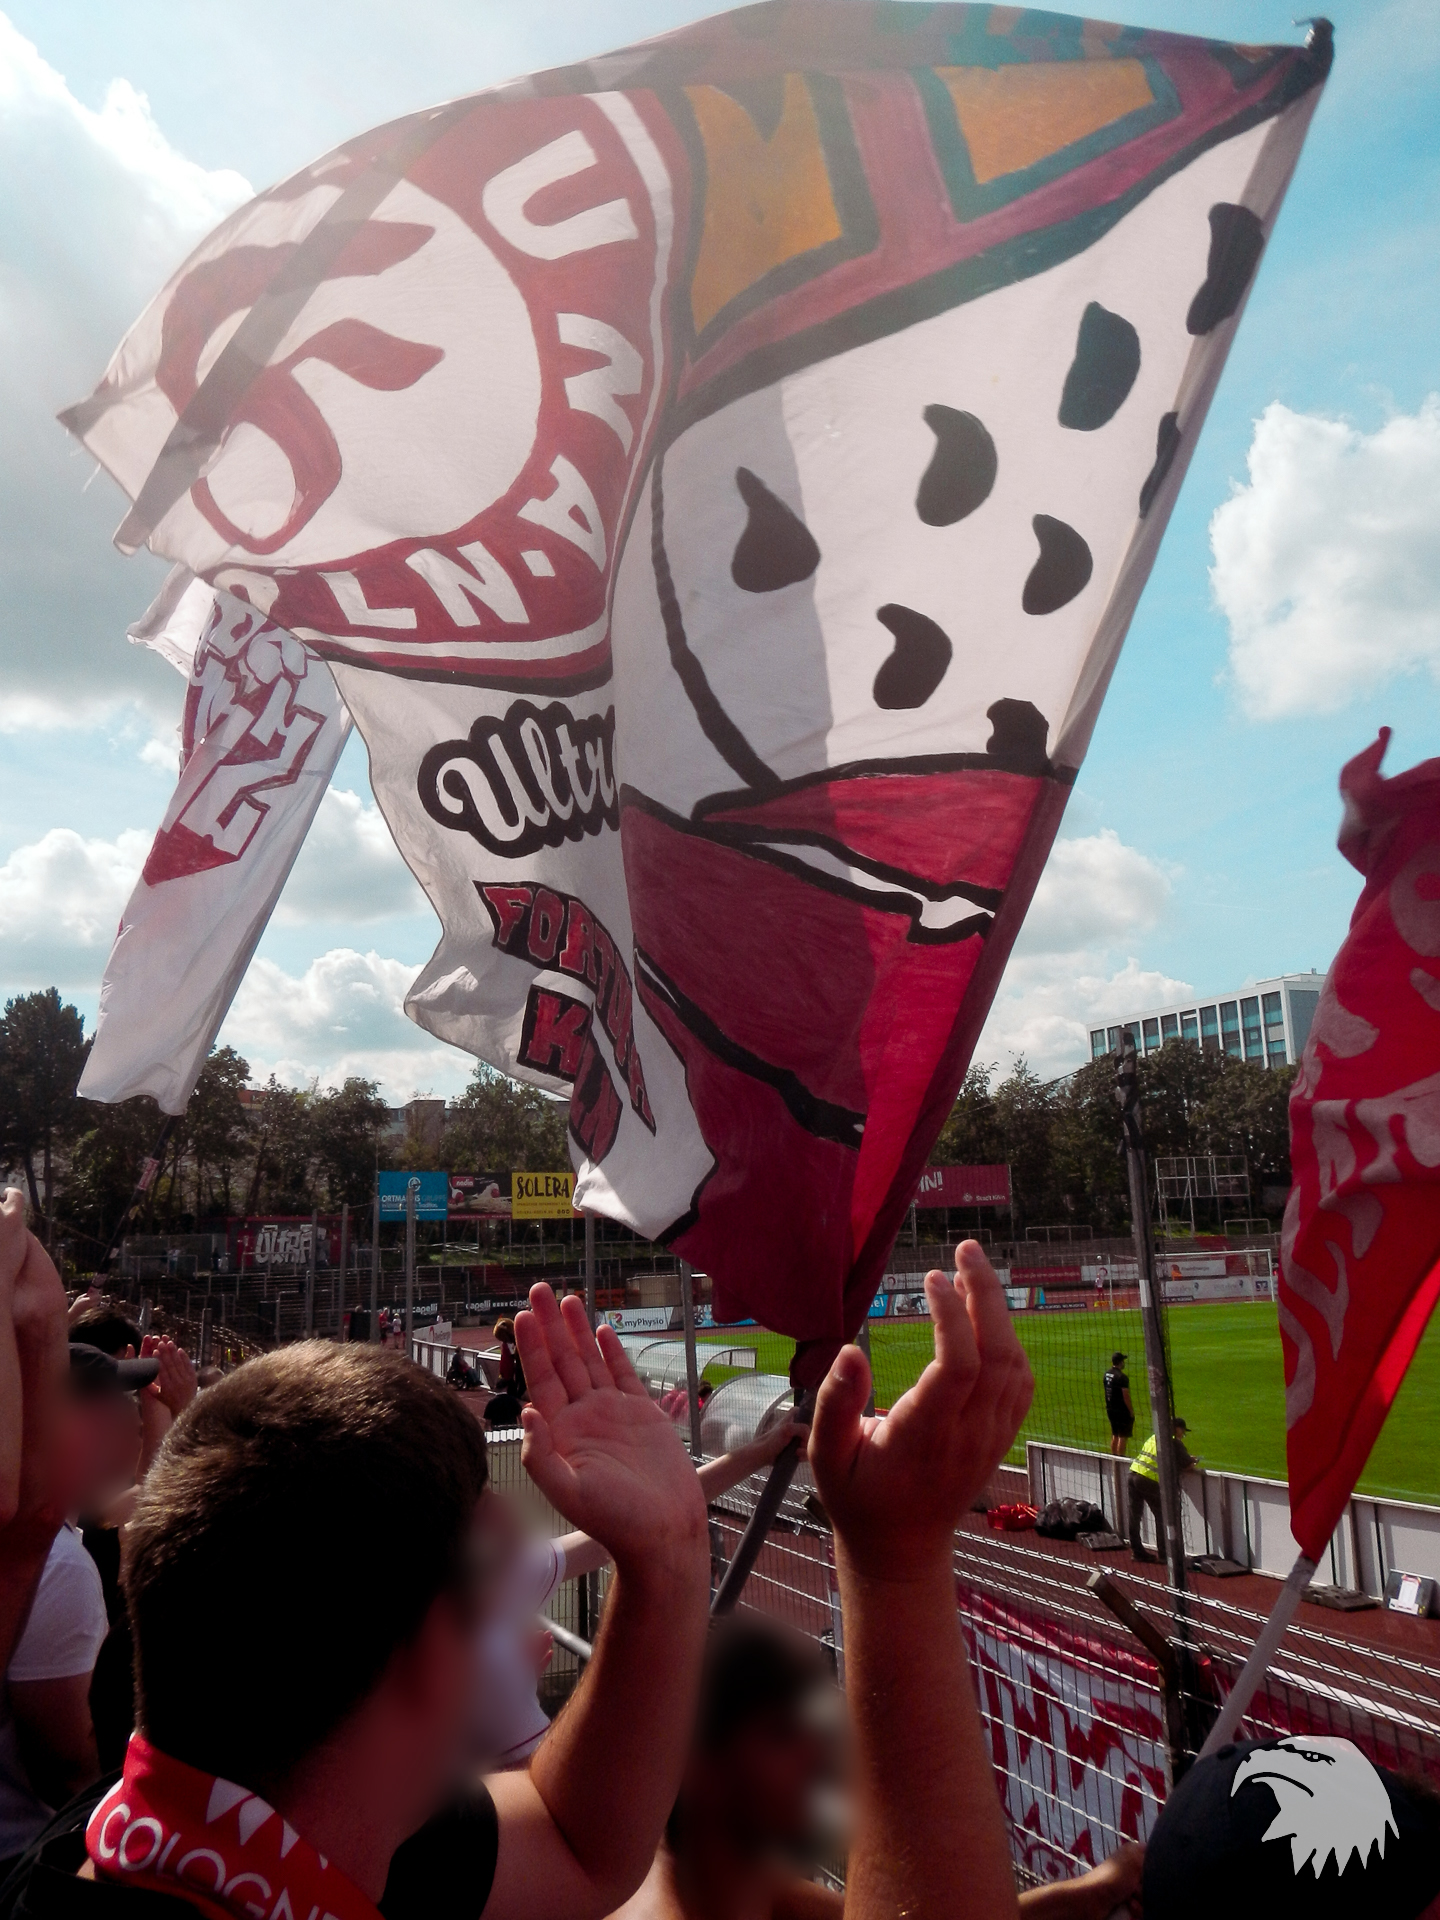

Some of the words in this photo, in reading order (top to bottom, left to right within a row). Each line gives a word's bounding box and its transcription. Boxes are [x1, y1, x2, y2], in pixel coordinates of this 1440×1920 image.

[516, 1175, 570, 1200] SOLERA
[381, 1194, 421, 1203] ORTMAS
[975, 1194, 992, 1202] Stadt
[509, 1298, 531, 1309] capel
[624, 1315, 664, 1328] myPhysio
[98, 1802, 342, 1920] COLOGN
